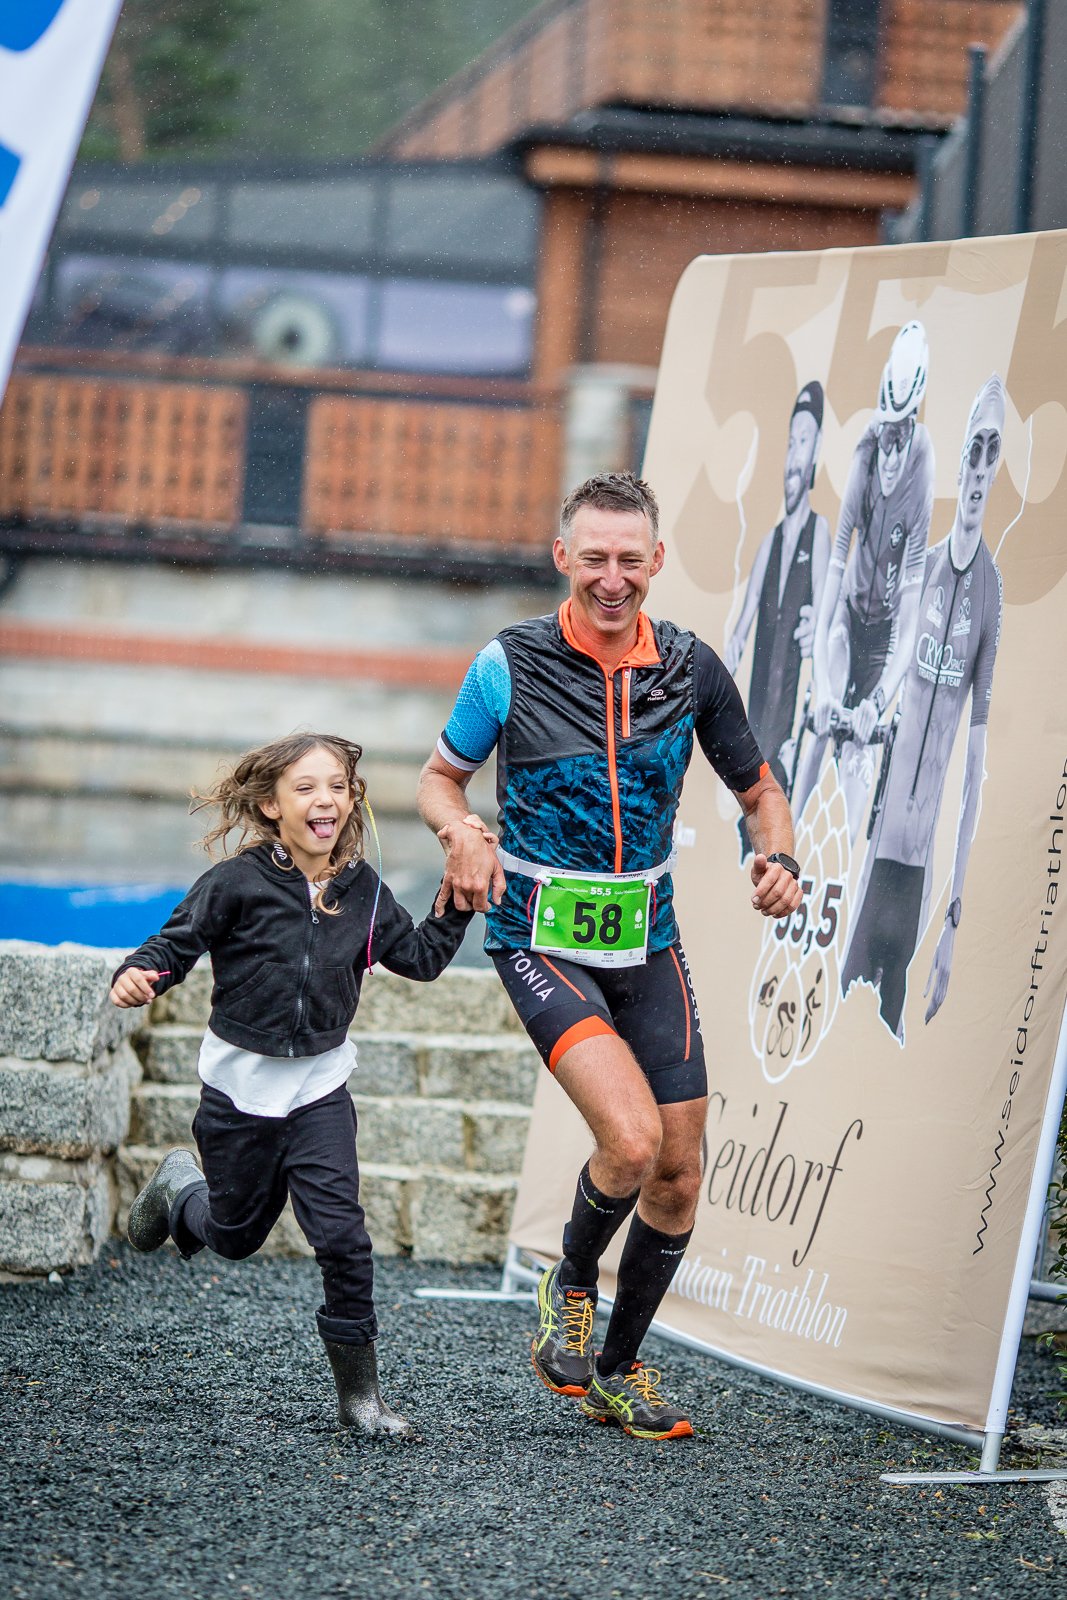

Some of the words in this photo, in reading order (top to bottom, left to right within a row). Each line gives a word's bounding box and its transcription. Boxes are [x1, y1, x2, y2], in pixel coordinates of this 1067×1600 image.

[590, 887, 612, 897] 55,5
[572, 901, 623, 944] 58
[509, 949, 556, 1001] TONIA
[667, 1247, 734, 1312] ntain
[734, 1253, 848, 1348] Triathlon
